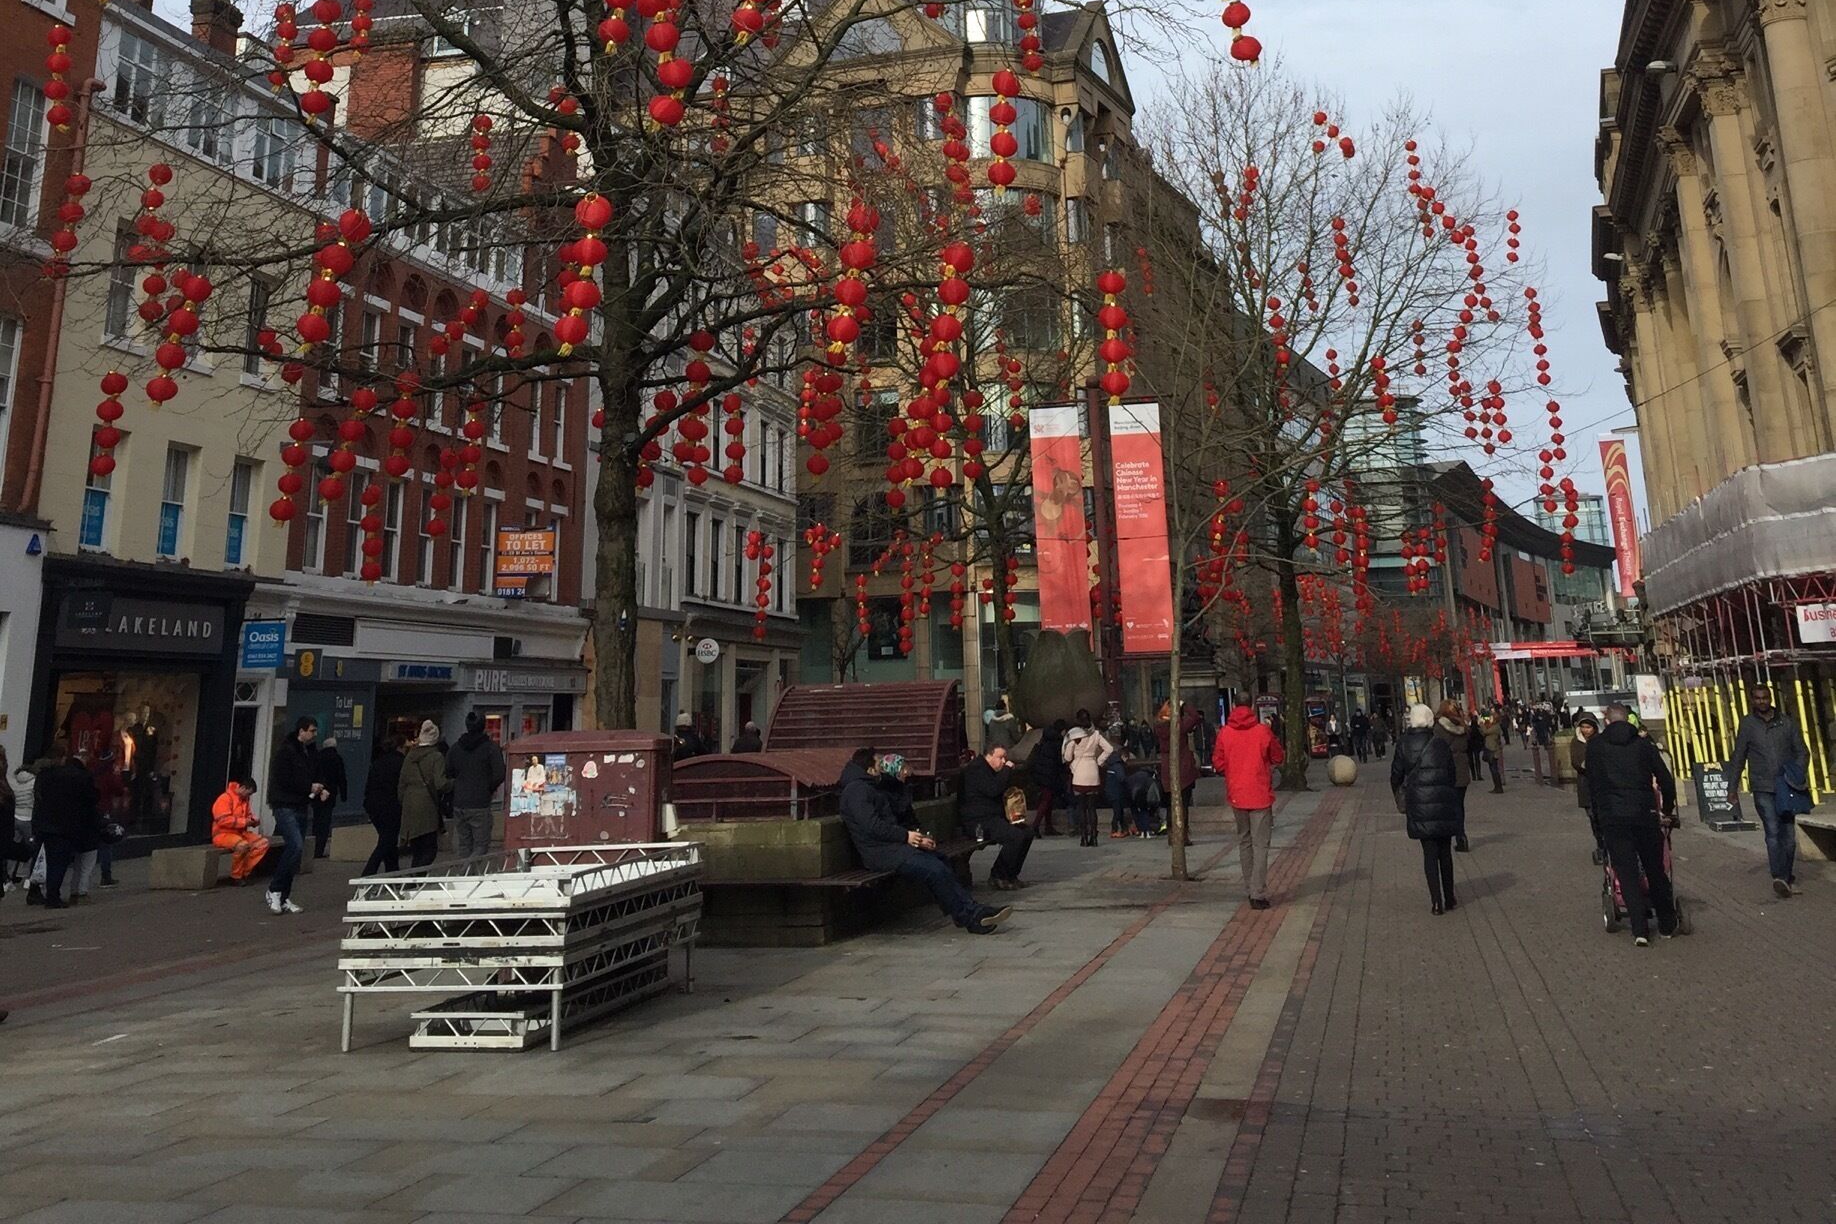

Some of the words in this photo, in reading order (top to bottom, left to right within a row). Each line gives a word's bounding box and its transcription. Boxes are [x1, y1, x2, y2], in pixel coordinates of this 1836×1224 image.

[1116, 469, 1143, 477] Chinese
[1117, 483, 1158, 491] Manchester
[505, 541, 520, 550] TO
[525, 540, 547, 550] LET
[540, 563, 550, 571] FT
[249, 631, 279, 642] Oasis
[475, 669, 508, 692] PURE
[335, 696, 343, 709] To
[343, 695, 353, 709] Let
